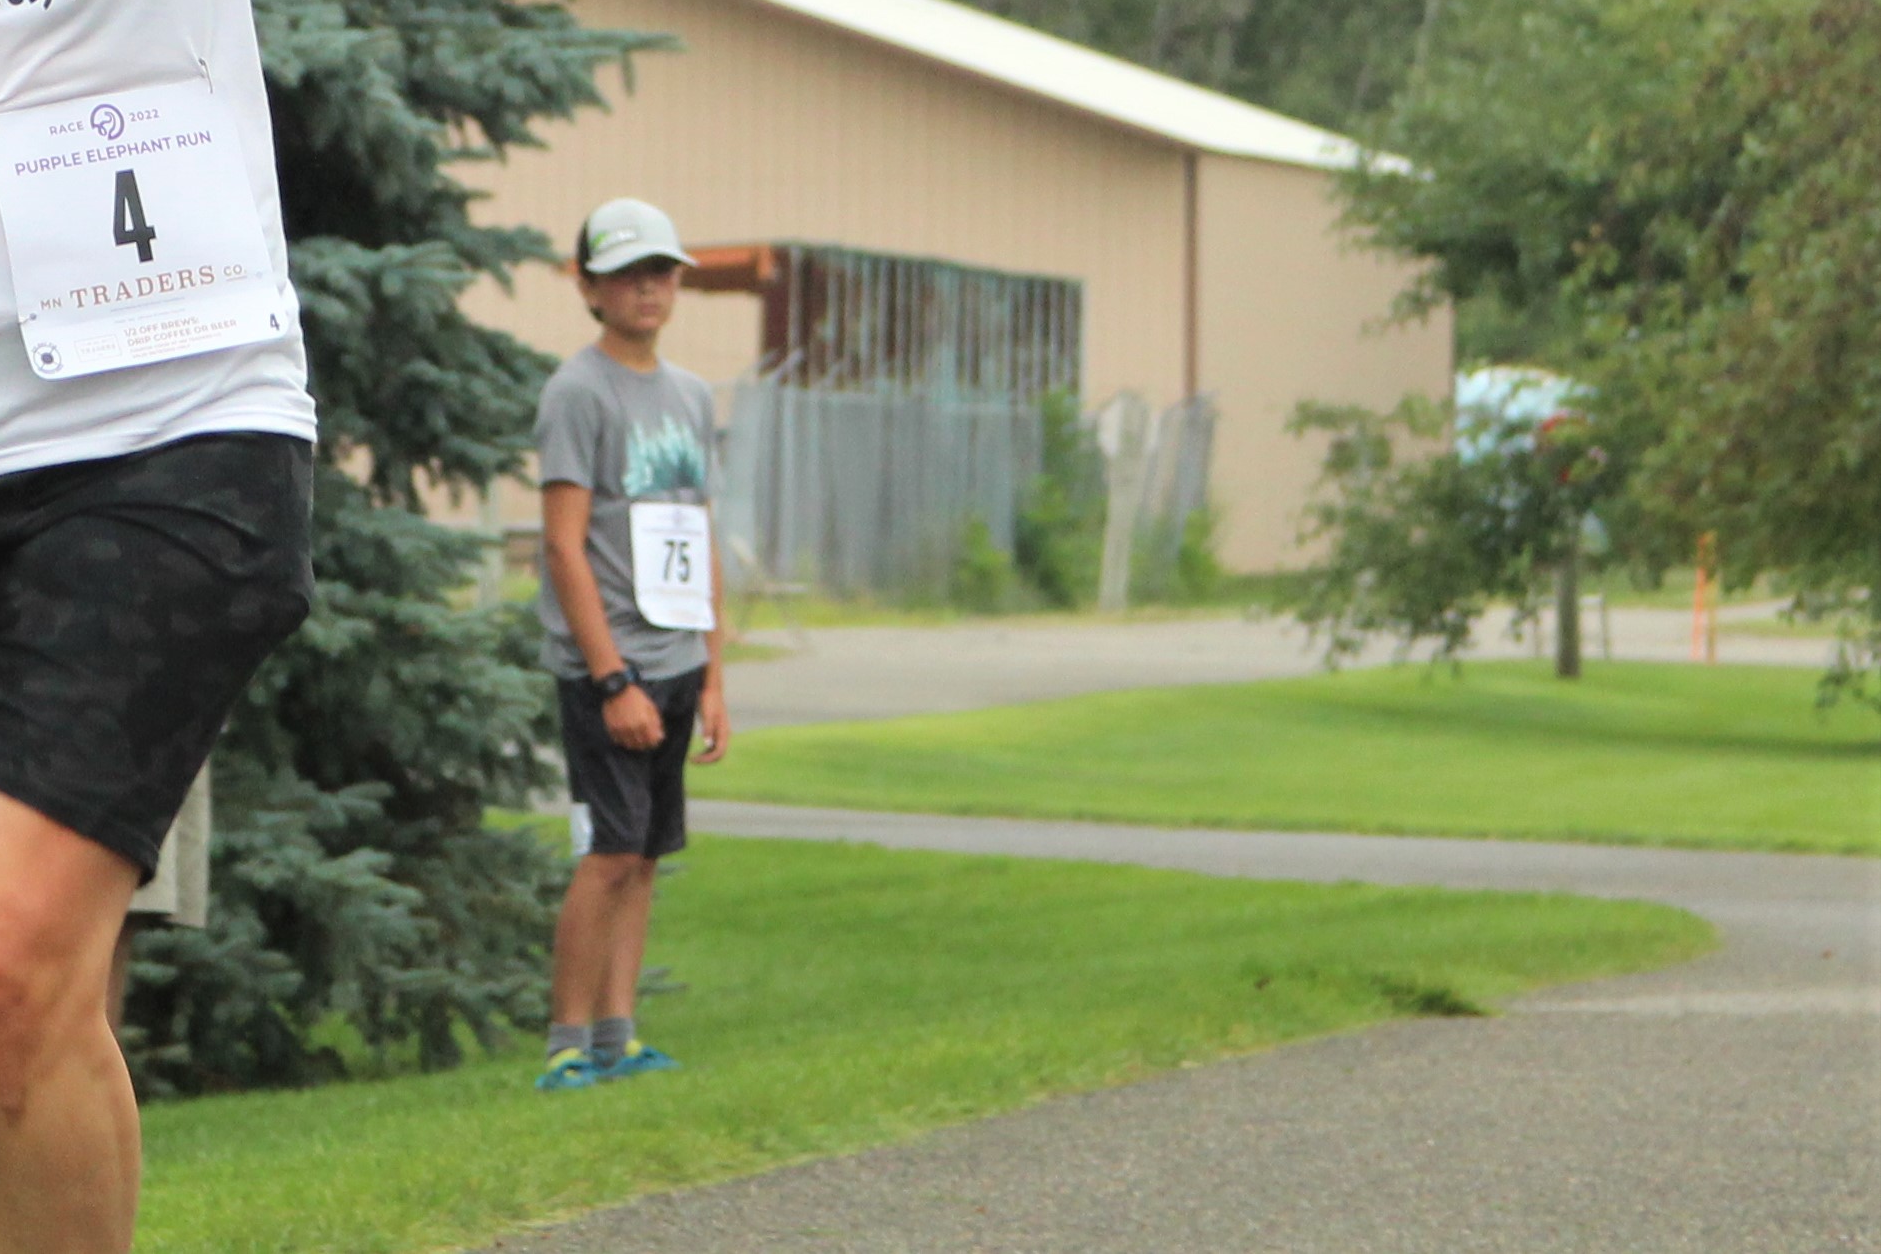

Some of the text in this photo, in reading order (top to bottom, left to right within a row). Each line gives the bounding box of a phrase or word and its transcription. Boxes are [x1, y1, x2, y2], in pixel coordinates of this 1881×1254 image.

[49, 108, 160, 136] RACE 2022
[15, 130, 212, 176] PURPLE ELEPHANT RUN
[112, 168, 157, 264] 4
[40, 297, 63, 311] MN
[70, 264, 217, 309] TRADERS
[139, 323, 159, 334] OFF
[153, 328, 191, 342] COFFEE
[194, 324, 209, 334] OR
[211, 319, 238, 331] BEER
[269, 313, 280, 332] 4
[662, 539, 692, 584] 75
